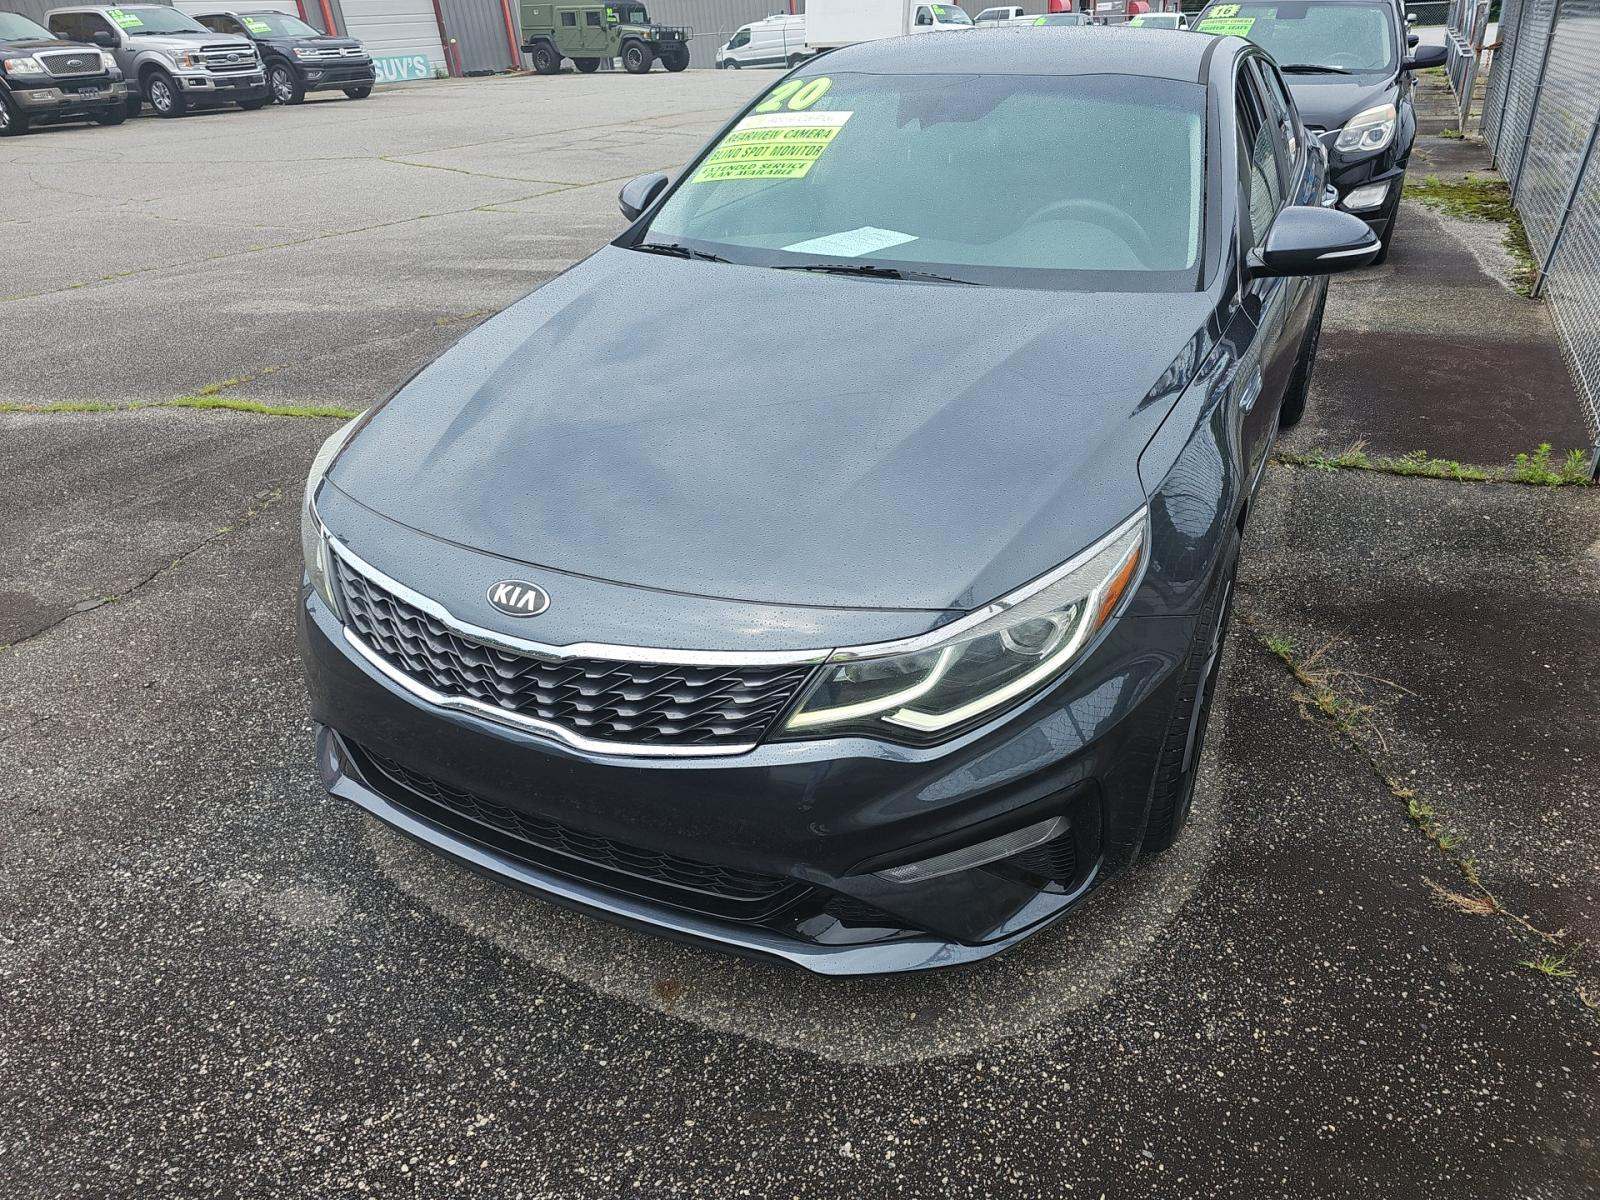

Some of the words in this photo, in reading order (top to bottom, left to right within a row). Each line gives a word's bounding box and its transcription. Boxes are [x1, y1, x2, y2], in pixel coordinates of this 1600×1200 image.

[1216, 7, 1232, 15] 16
[755, 76, 833, 113] 20
[725, 129, 782, 144] REARVIEW
[783, 128, 833, 140] CAMERA
[710, 147, 742, 161] BLIND
[742, 146, 770, 158] SPOT
[769, 145, 824, 157] MONITOR
[702, 163, 757, 174] EXTENDED
[759, 162, 805, 170] SERVICE
[704, 170, 735, 179] PLAN
[737, 169, 794, 177] AVAILABLE
[493, 583, 536, 611] KIA
